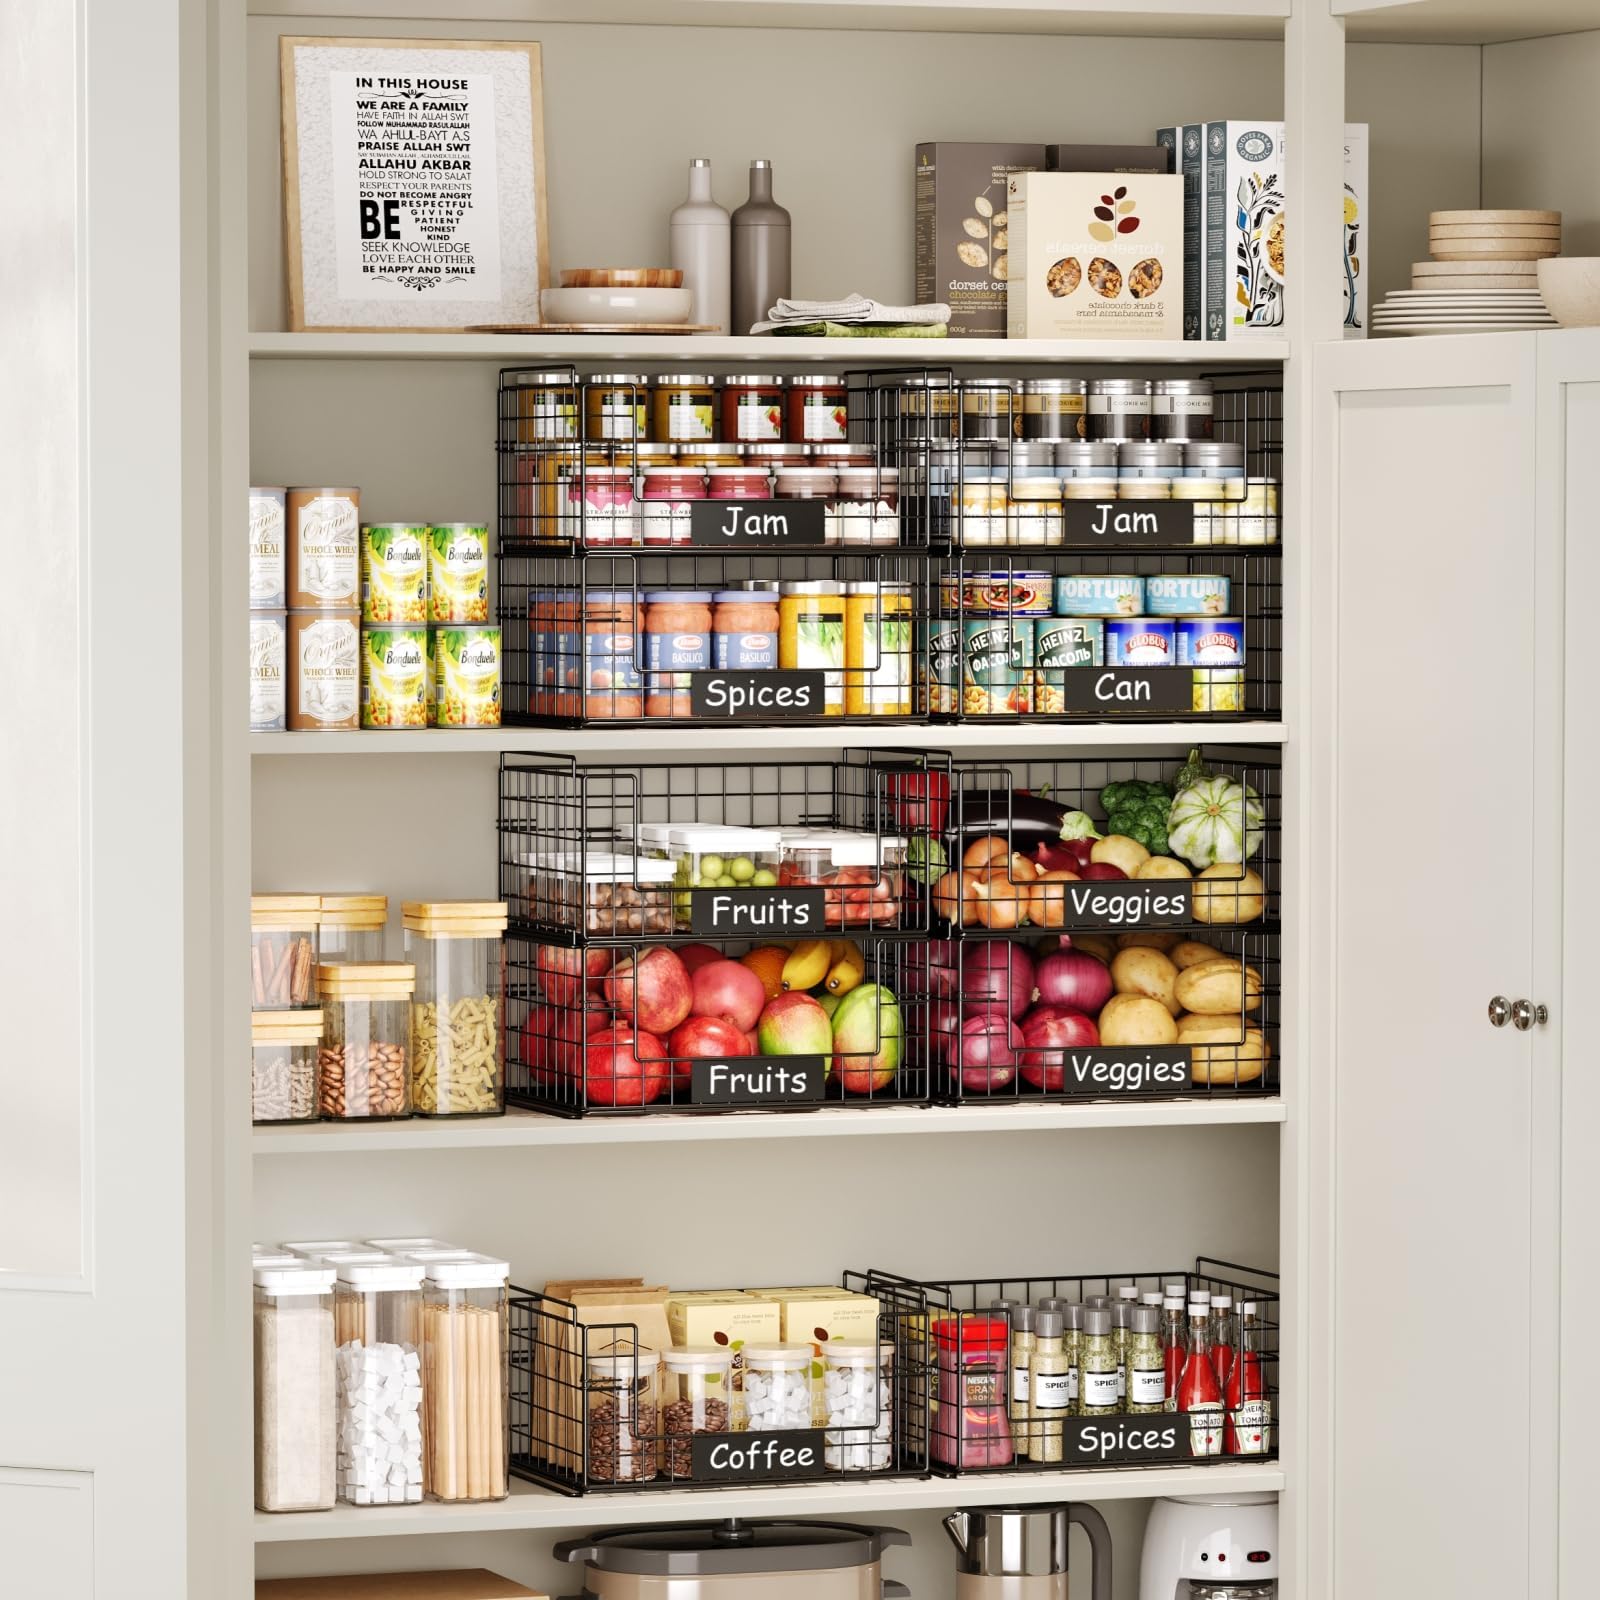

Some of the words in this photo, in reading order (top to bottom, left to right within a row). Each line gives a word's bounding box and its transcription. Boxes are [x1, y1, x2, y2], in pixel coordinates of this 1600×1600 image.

[356, 78, 372, 88] IN
[378, 78, 411, 88] THIS
[417, 80, 468, 90] HOUSE
[357, 101, 376, 110] WE
[381, 102, 406, 110] ARE
[409, 102, 419, 110] A
[423, 102, 468, 111] FAMILY
[358, 130, 378, 140] WA
[358, 142, 400, 150] PRAISE
[403, 143, 442, 151] ALLAH
[1240, 149, 1270, 160] ORGANIC
[359, 159, 416, 168] ALLAHU
[422, 160, 471, 170] AKBAR
[388, 172, 426, 180] STRONG
[360, 200, 400, 240] BE
[361, 242, 388, 252] SEEK
[392, 242, 470, 253] KNOWLEDGE
[362, 254, 395, 264] LOVE
[398, 254, 431, 264] EACH
[434, 254, 475, 264] OTHER
[949, 280, 988, 290] dorset
[722, 506, 788, 536] Jam
[1092, 504, 1158, 534] Jam
[303, 546, 333, 554] WHOLE
[387, 547, 421, 564] Bonduelle
[448, 546, 482, 563] Bonduelle
[1042, 630, 1082, 652] HEINZ
[1129, 634, 1165, 649] GLOBUS
[1200, 634, 1236, 648] GLOBUS
[387, 651, 421, 667] Bonduelle
[462, 650, 496, 666] Bonduelle
[672, 652, 703, 663] BASILICO
[740, 652, 770, 663] BASILICO
[1042, 648, 1091, 668] ФАСОЛЬ
[303, 668, 333, 676] WHOLE
[1094, 672, 1151, 700] Can
[705, 680, 810, 715] Spices
[712, 896, 810, 926] Fruits
[1071, 888, 1185, 923] Veggies
[710, 1065, 807, 1094] Fruits
[1072, 1055, 1186, 1090] Veggies
[968, 1386, 995, 1394] GRAN
[1078, 1424, 1176, 1459] Spices
[710, 1440, 814, 1470] Coffee
